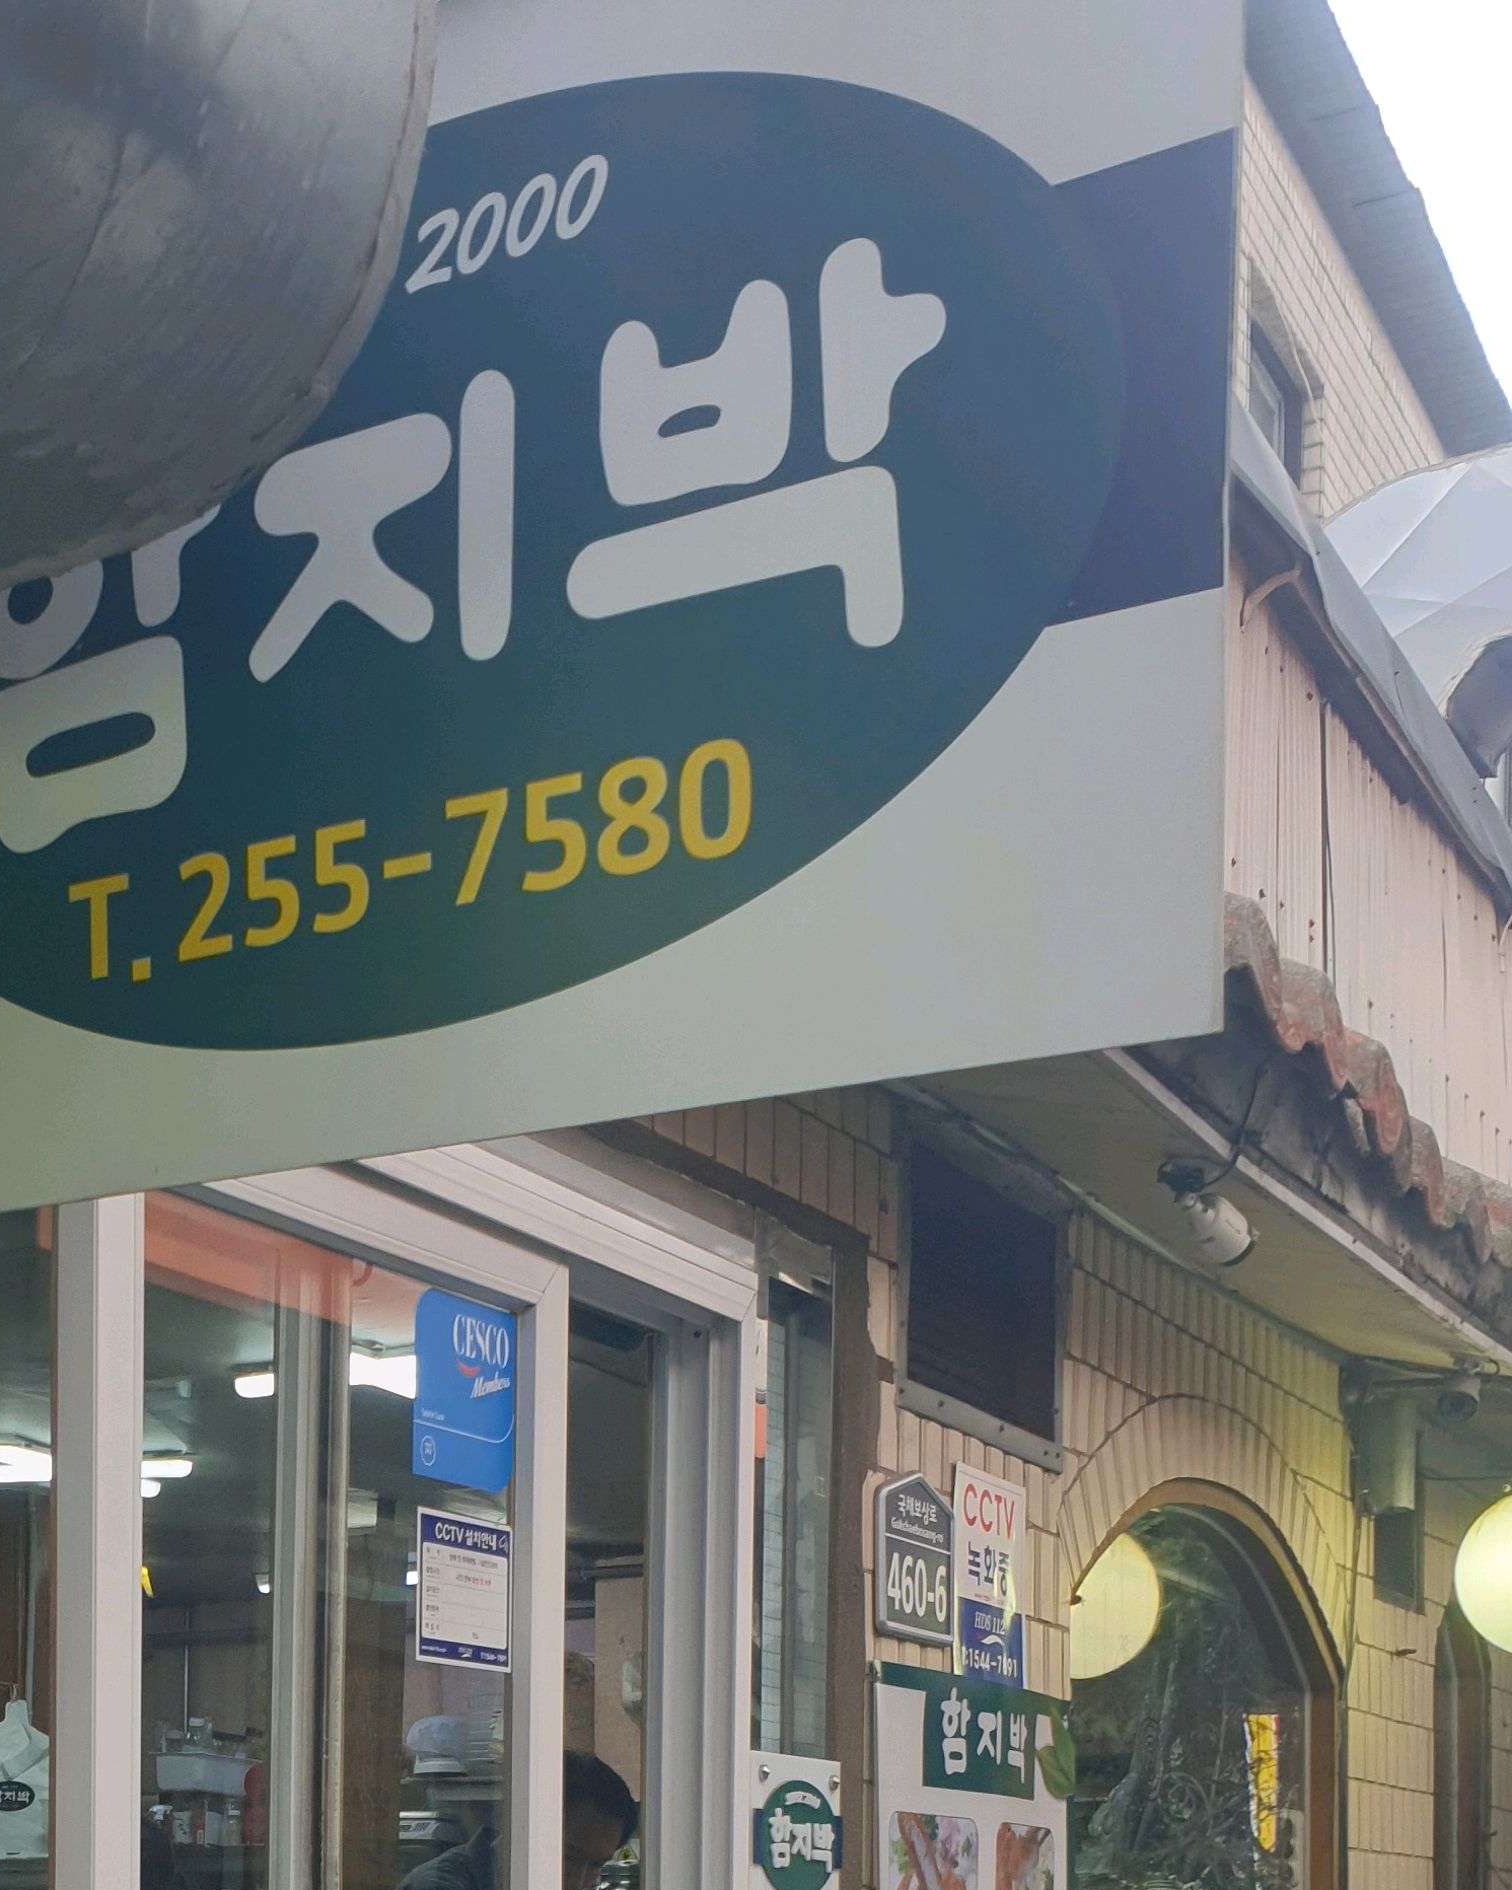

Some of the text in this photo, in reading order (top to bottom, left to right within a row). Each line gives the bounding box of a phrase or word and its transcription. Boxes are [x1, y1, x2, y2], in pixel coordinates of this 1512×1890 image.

[403, 153, 610, 295] 2000
[453, 1313, 510, 1369] CESCO
[470, 1371, 511, 1399] Members
[434, 1521, 465, 1544] CCTV
[963, 1483, 1015, 1540] CCTV
[887, 1551, 948, 1623] 460-6
[967, 1540, 1011, 1598] 녹화중
[940, 1686, 1028, 1785] 함지박
[768, 1807, 836, 1874] 함지박
